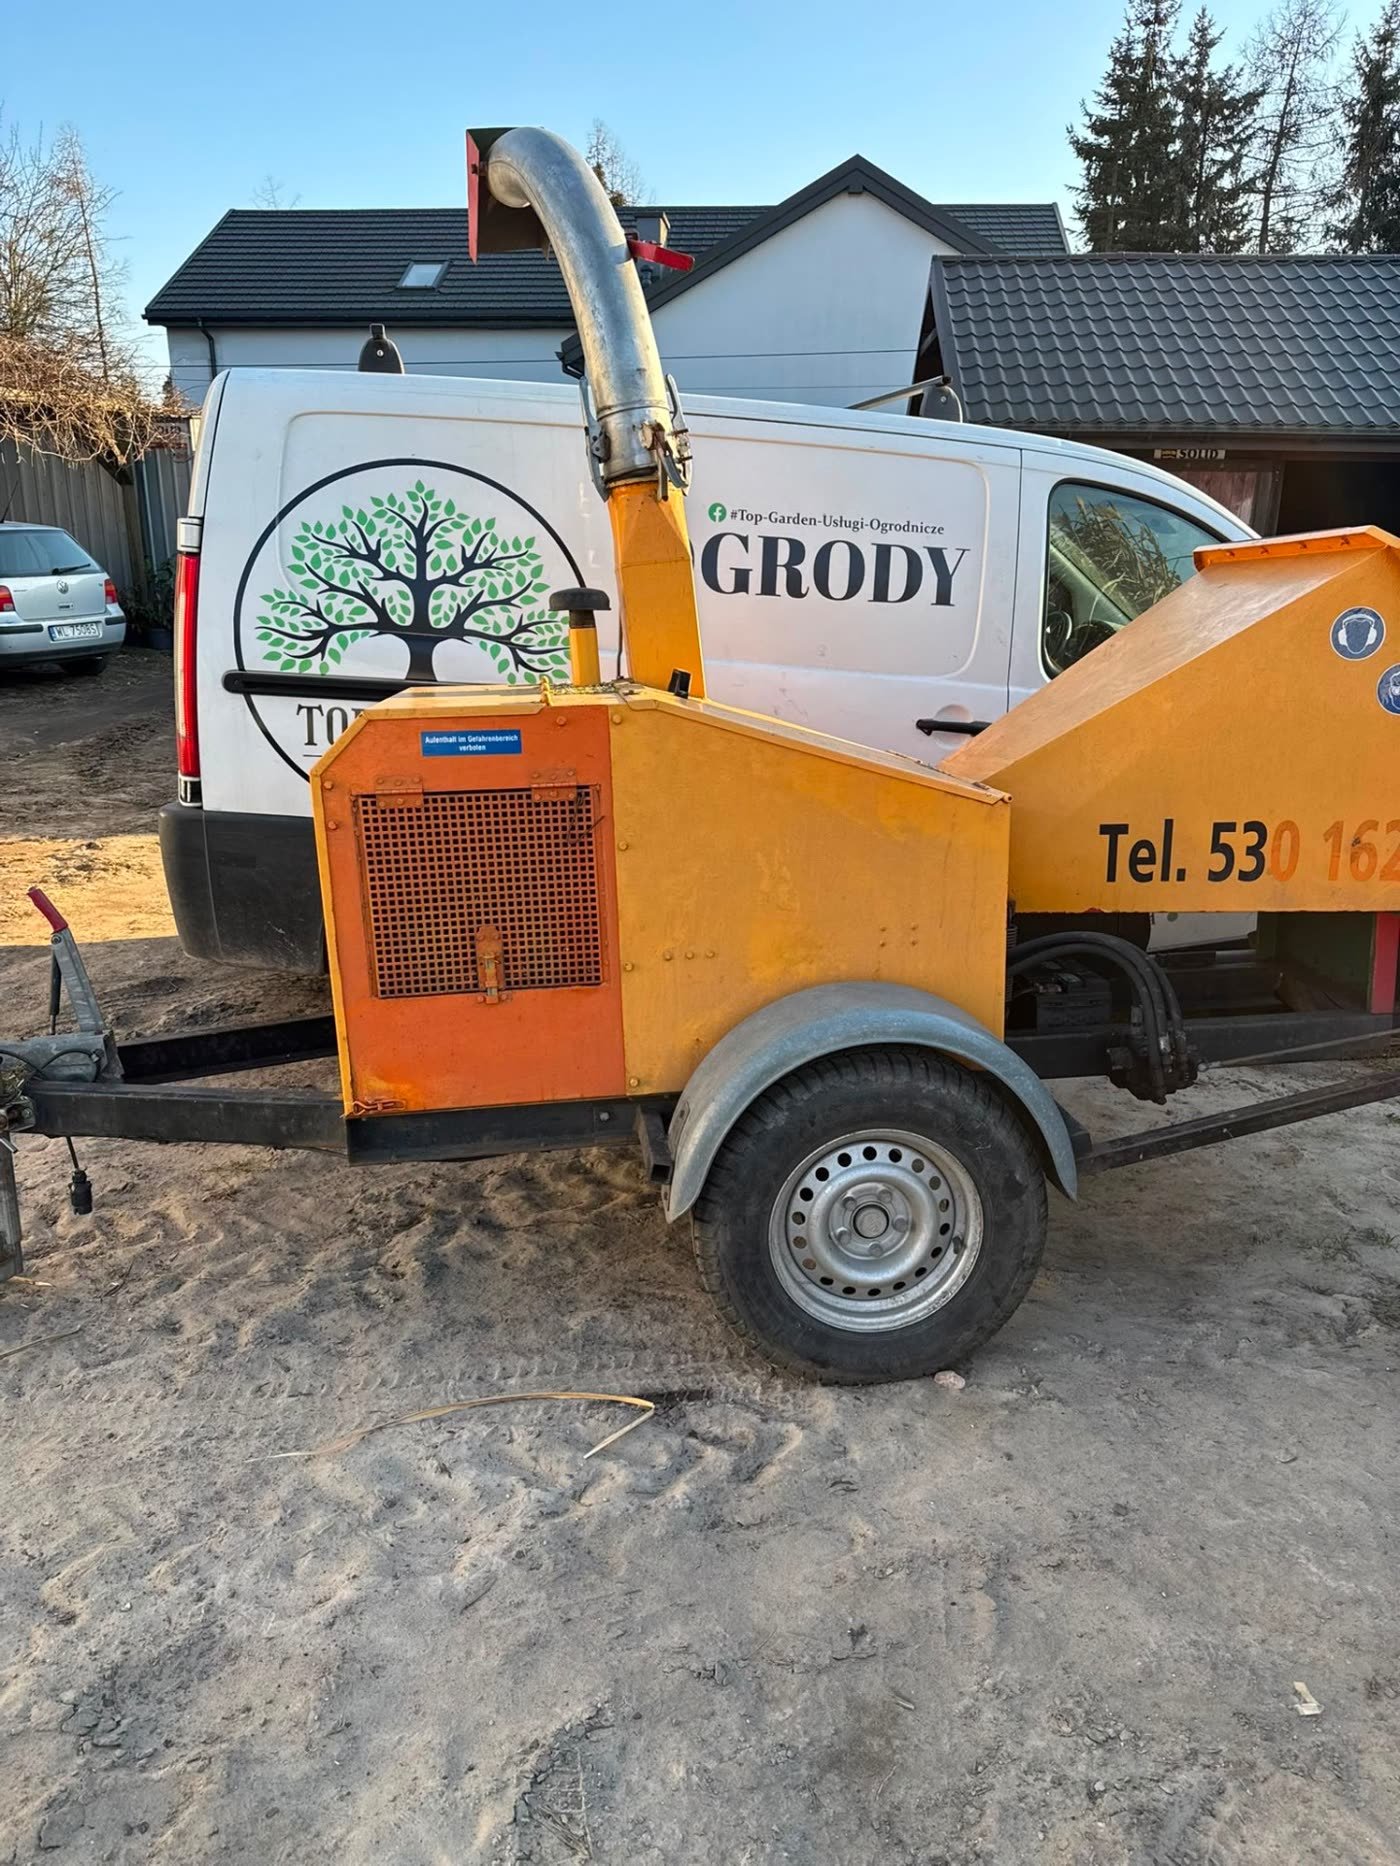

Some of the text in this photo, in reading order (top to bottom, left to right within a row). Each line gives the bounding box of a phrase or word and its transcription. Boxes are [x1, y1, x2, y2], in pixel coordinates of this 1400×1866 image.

[730, 508, 945, 535] #Top-Garden-Usługi-Ogrodnicze
[689, 531, 971, 607] GRODY
[296, 703, 364, 746] TO
[425, 734, 518, 743] Aufenthalt im Gefahrenbereich
[1098, 818, 1187, 883] Tel.
[1207, 819, 1301, 883] 530
